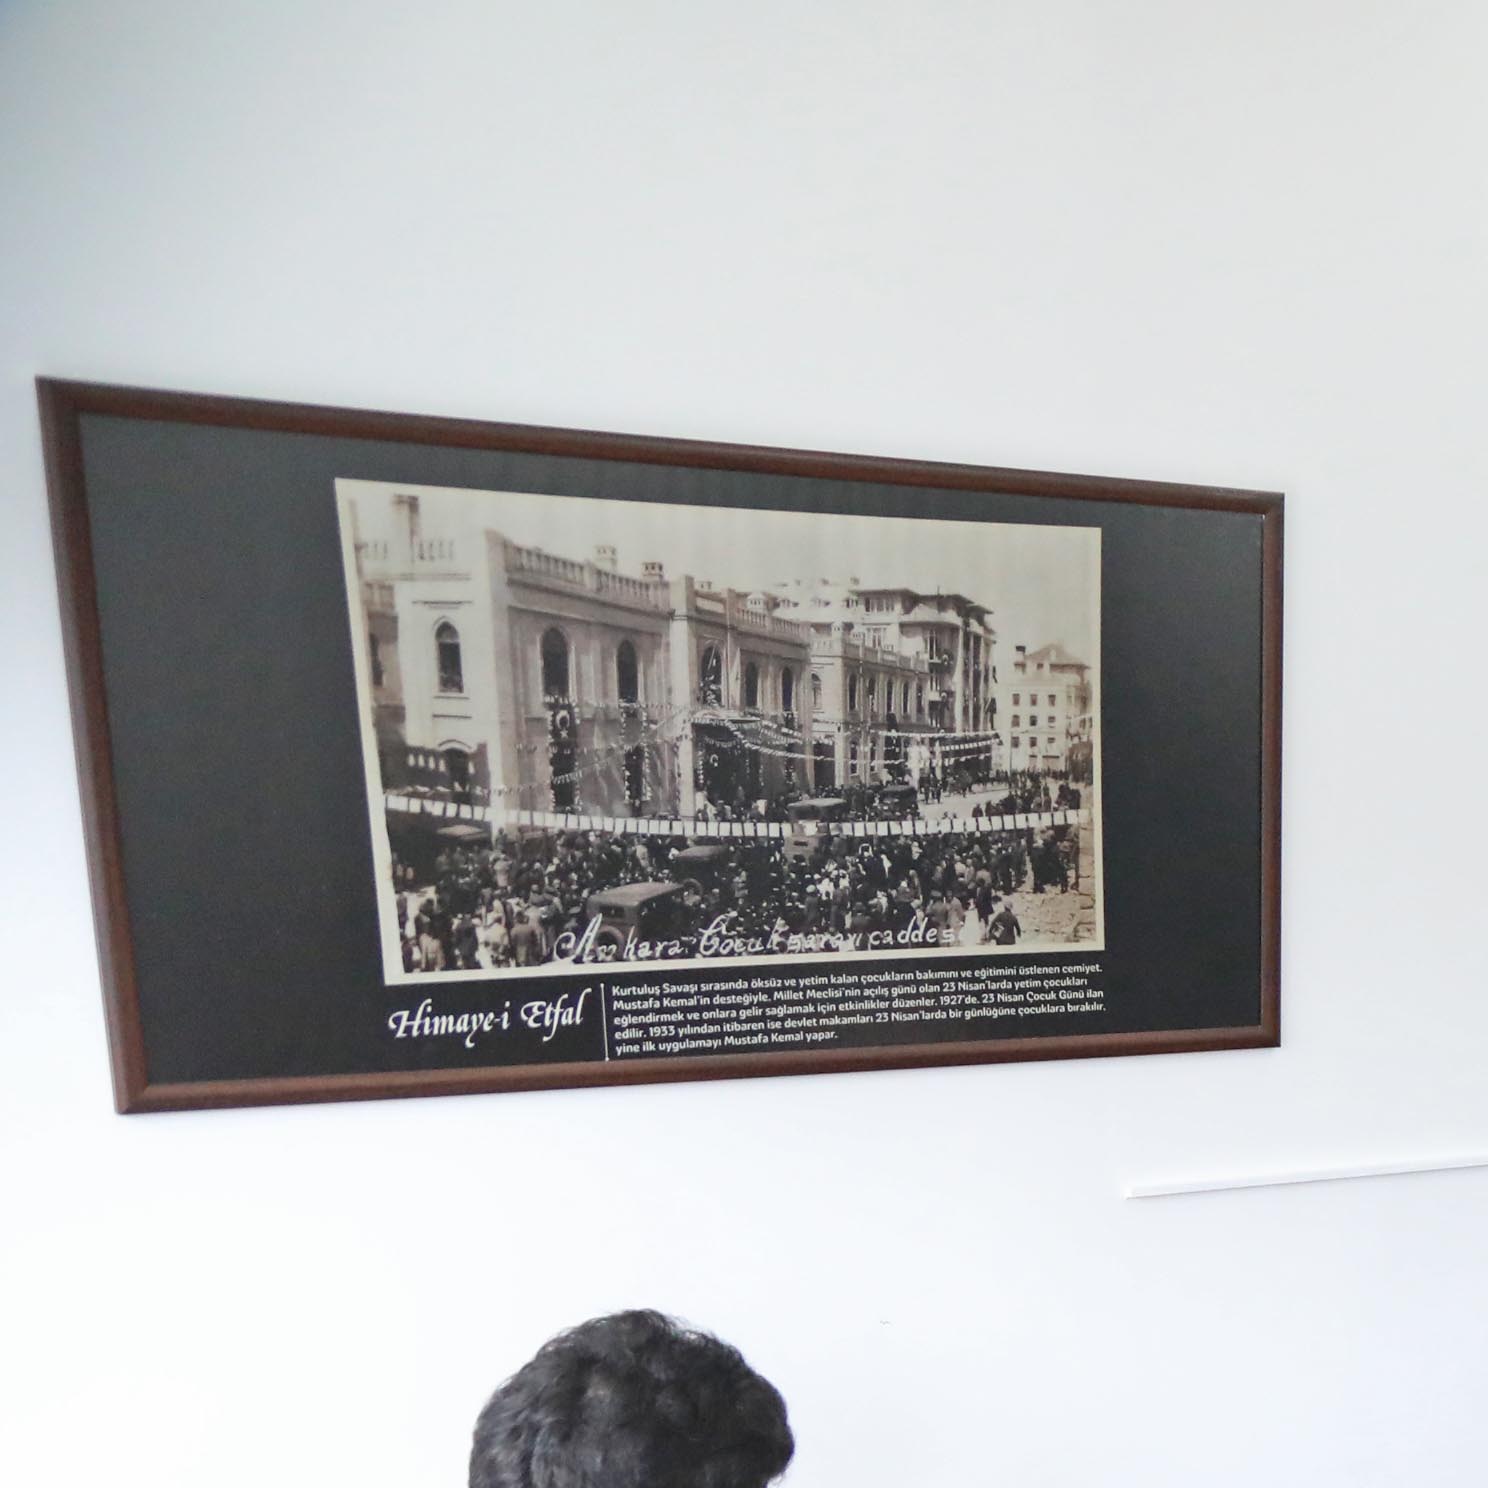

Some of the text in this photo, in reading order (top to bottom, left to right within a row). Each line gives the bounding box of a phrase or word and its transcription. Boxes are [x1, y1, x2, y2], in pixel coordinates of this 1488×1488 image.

[612, 983, 660, 996] Kurtuluş
[662, 982, 698, 994] Savaşı
[700, 979, 748, 992] sırasında
[750, 977, 782, 989] öksüz
[784, 979, 796, 988] ve
[798, 975, 828, 989] yetim
[830, 974, 858, 985] kalan
[860, 971, 914, 986] çocukların
[916, 970, 958, 981] bakımını
[960, 970, 972, 979] ve
[974, 966, 1016, 981] eğitimini
[1018, 964, 1060, 976] üstlenen
[612, 997, 660, 1010] Mustafa
[772, 989, 804, 1002] Millet
[862, 985, 890, 999] açılış
[890, 984, 916, 998] günü
[918, 983, 940, 994] olan
[942, 982, 956, 993] 23
[1014, 978, 1042, 992] yetim
[1042, 976, 1088, 990] çocukları
[387, 987, 592, 1049] Himaye-i Etfal
[614, 1009, 684, 1026] eğlendirmek
[686, 1011, 700, 1020] ve
[702, 1007, 736, 1019] onlara
[738, 1005, 764, 1019] gelir
[764, 1002, 816, 1017] sağlamak
[816, 1001, 836, 1015] için
[838, 999, 890, 1012] etkinlikler
[892, 997, 938, 1009] düzenler.
[982, 993, 994, 1004] 23
[996, 992, 1024, 1004] Nisan
[1026, 990, 1058, 1004] Çocuk
[1058, 988, 1084, 1000] Günü
[1086, 988, 1104, 999] ilan
[614, 1027, 648, 1039] edilir.
[648, 1025, 676, 1037] 1933
[678, 1023, 720, 1038] yılından
[722, 1021, 764, 1033] itibaren
[766, 1019, 782, 1030] ise
[784, 1016, 818, 1029] devlet
[818, 1014, 874, 1027] makamları
[874, 1012, 888, 1024] 23
[948, 1008, 964, 1019] bir
[964, 1005, 1016, 1021] günlüğüne
[1018, 1002, 1066, 1017] çocuklara
[614, 1030, 840, 1055] yine ilk uygulamayı Mustafa Kemal yapar.
